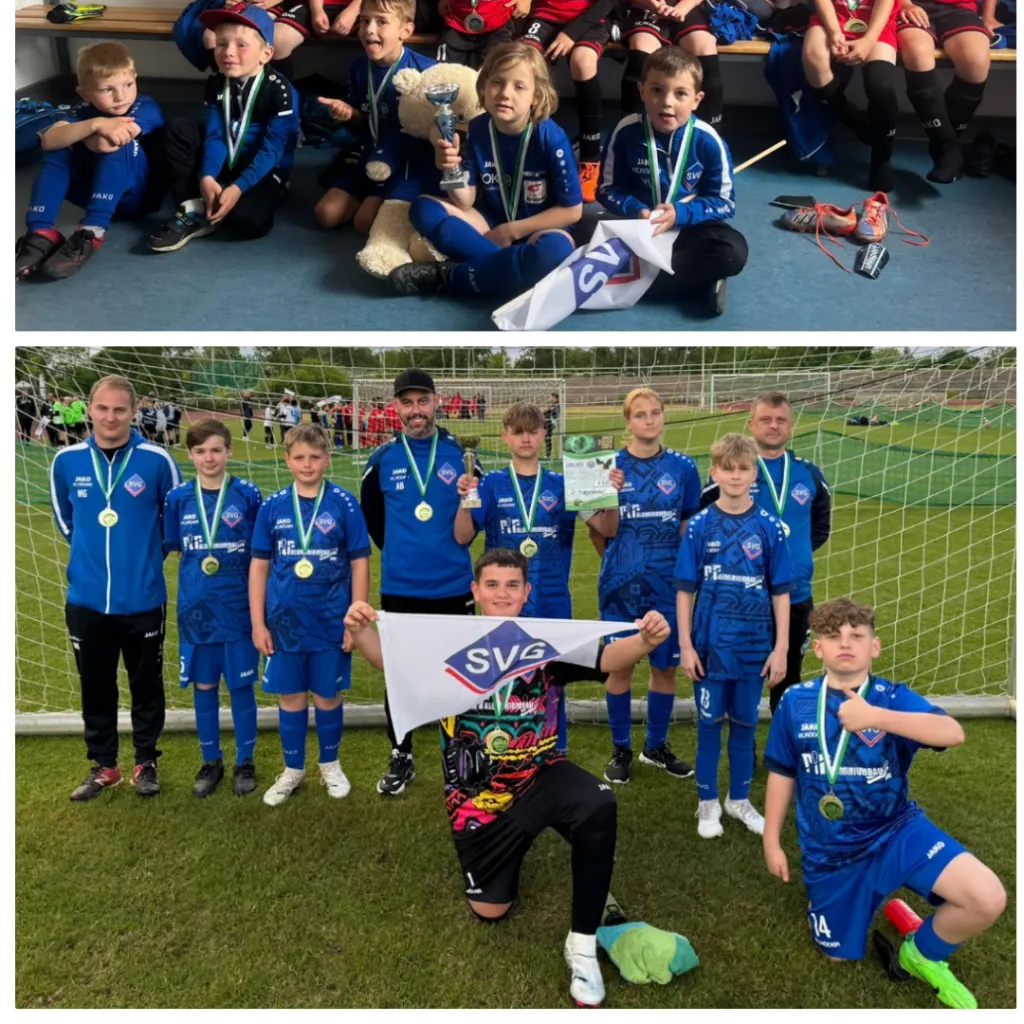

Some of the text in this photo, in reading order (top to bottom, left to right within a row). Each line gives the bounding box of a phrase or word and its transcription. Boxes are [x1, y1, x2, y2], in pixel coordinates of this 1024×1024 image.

[529, 22, 541, 34] 8
[578, 241, 622, 294] SV
[128, 480, 142, 489] SVG
[795, 488, 808, 496] SVG
[226, 511, 239, 520] SVG
[319, 518, 333, 526] SVG
[747, 541, 761, 551] SVG
[464, 640, 547, 675] SVG
[240, 669, 254, 678] JAKO
[926, 841, 945, 860] JAKO
[811, 912, 831, 938] 14
